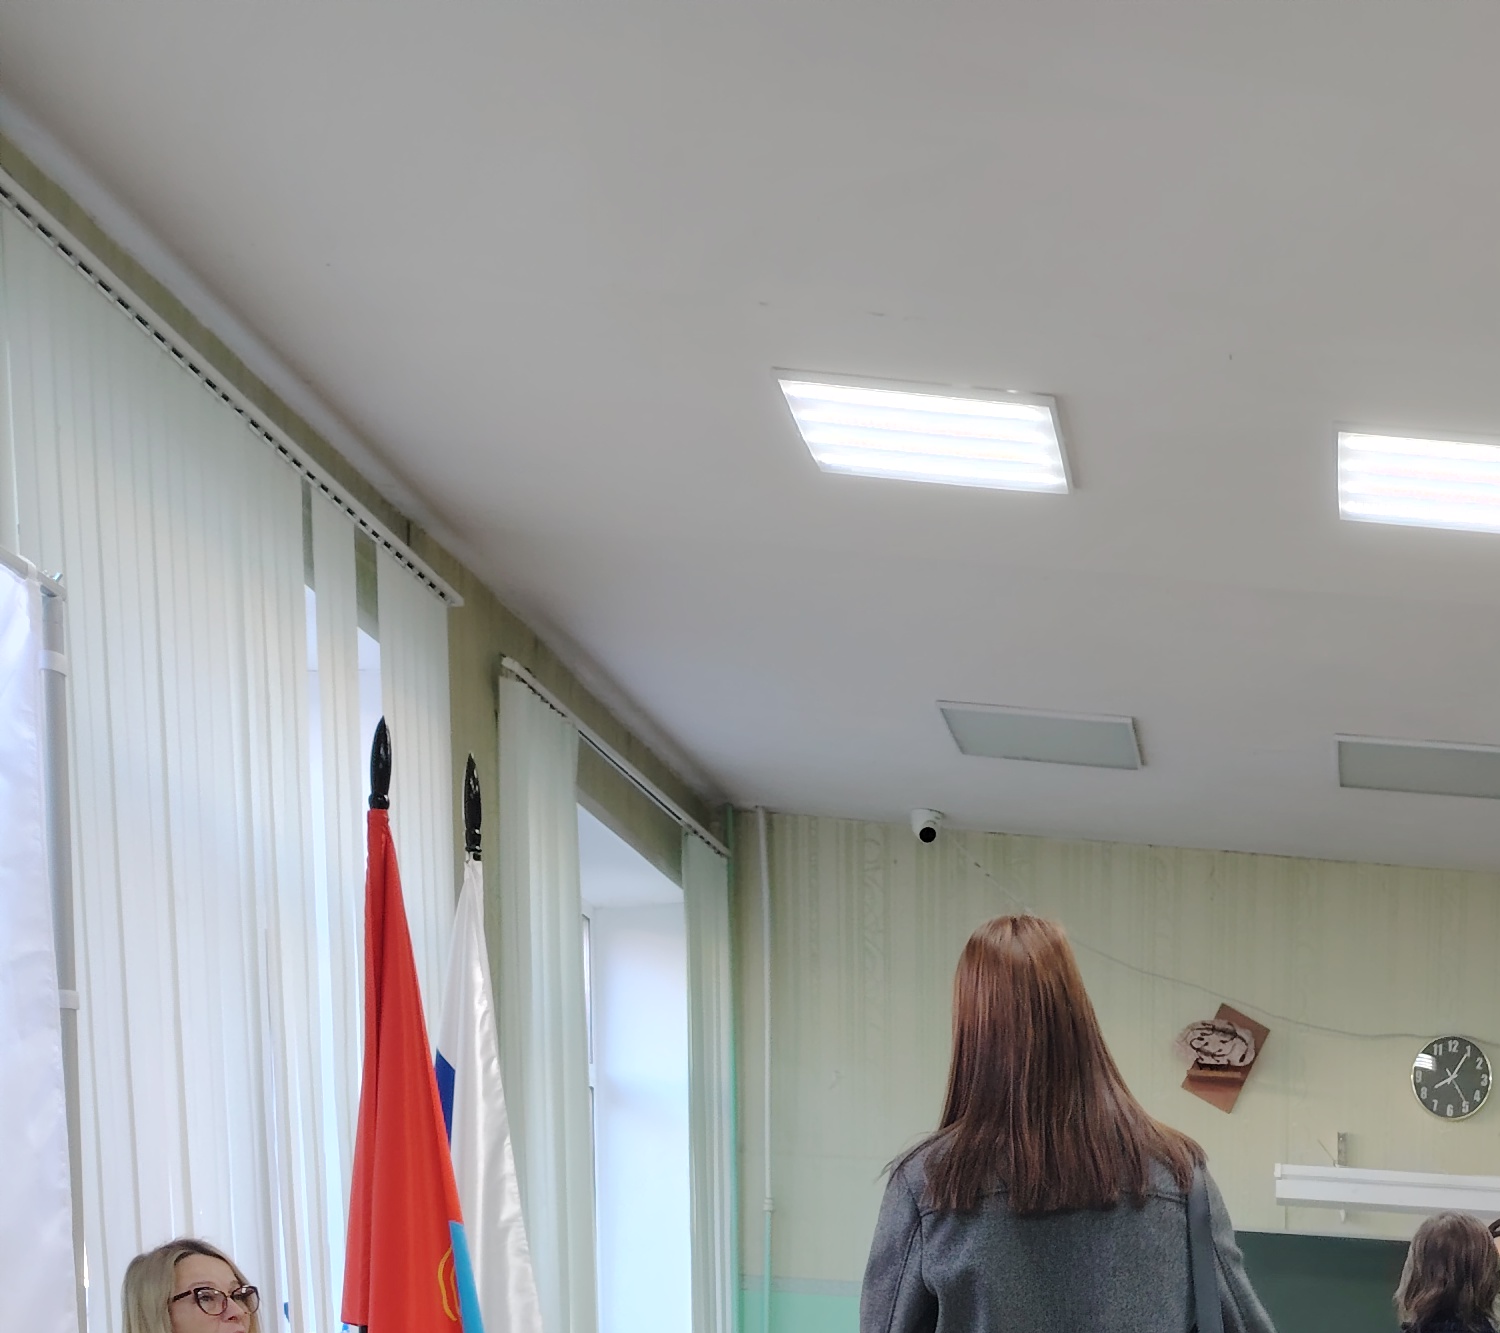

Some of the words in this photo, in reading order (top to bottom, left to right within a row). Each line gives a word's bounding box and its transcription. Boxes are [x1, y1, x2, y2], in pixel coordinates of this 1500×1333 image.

[1433, 1043, 1443, 1056] 11
[1448, 1040, 1459, 1053] 12
[1465, 1045, 1471, 1058] 1
[1475, 1056, 1483, 1070] 2
[1480, 1073, 1488, 1087] 3
[1420, 1086, 1428, 1100] 8
[1473, 1089, 1481, 1103] 4
[1432, 1099, 1439, 1112] 7
[1446, 1104, 1454, 1117] 6
[1462, 1100, 1470, 1113] 5
